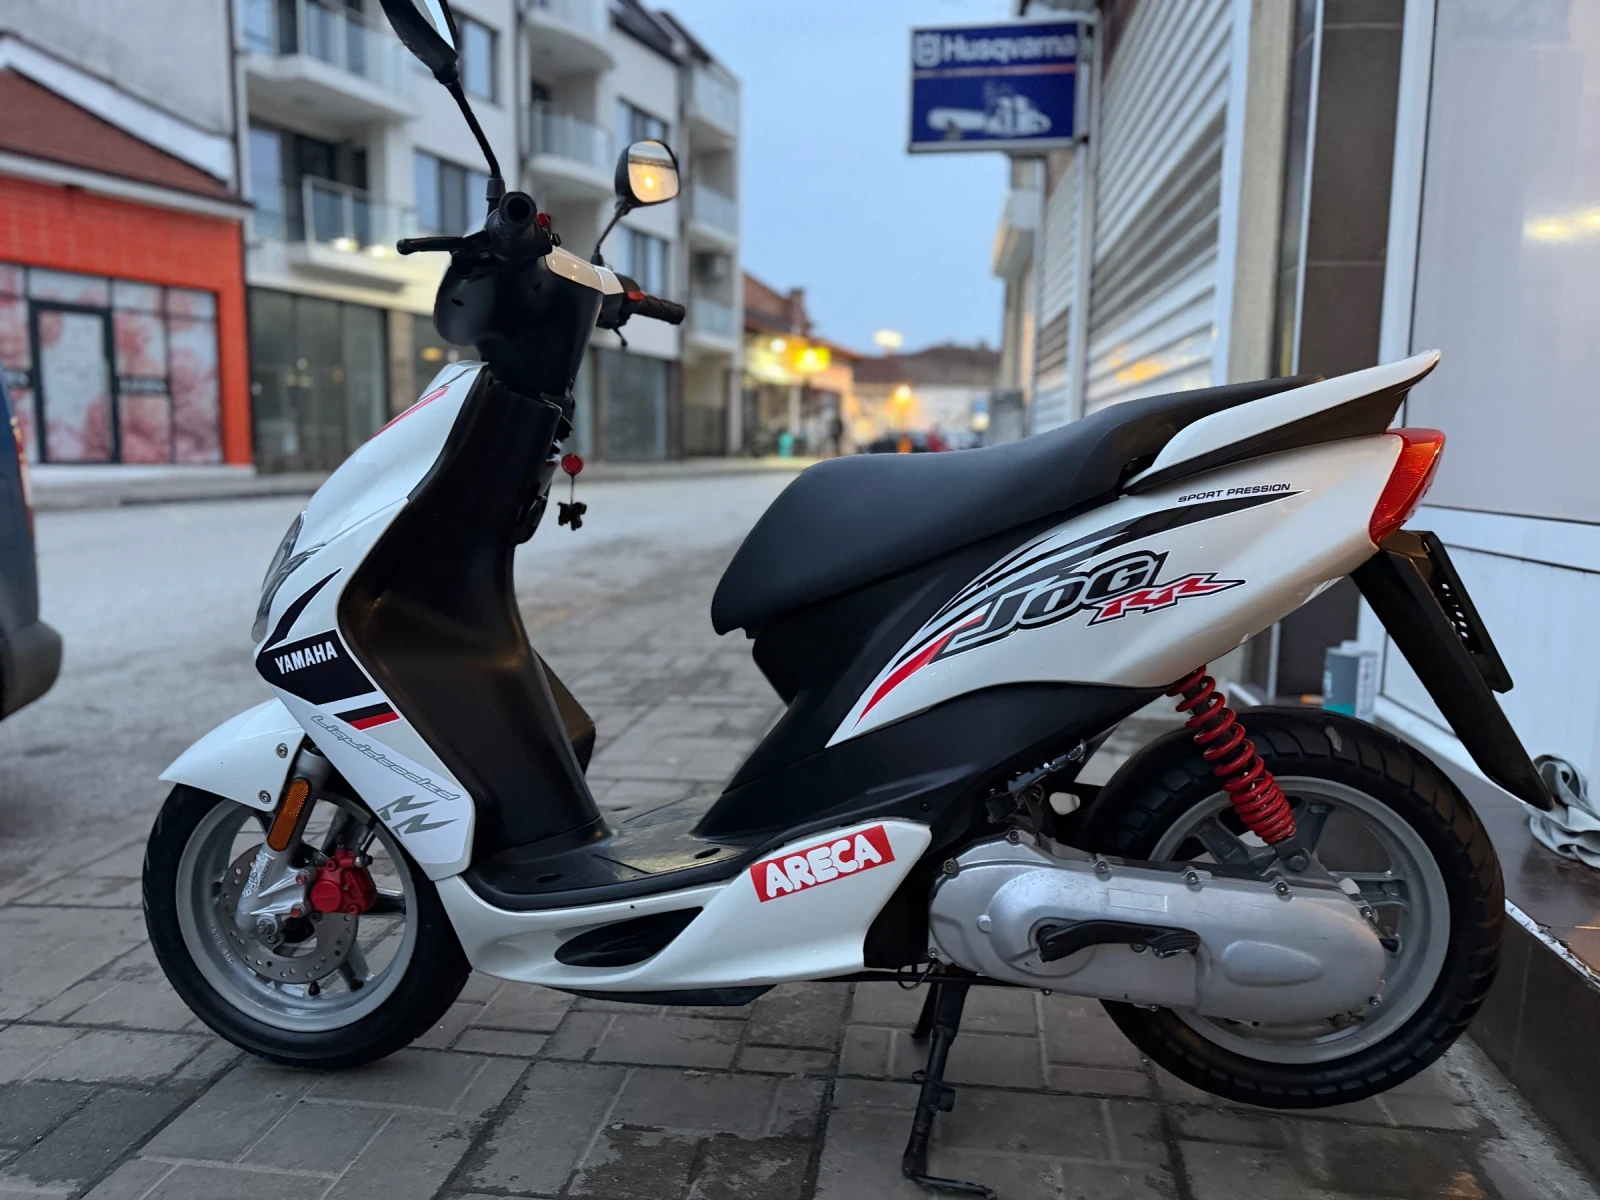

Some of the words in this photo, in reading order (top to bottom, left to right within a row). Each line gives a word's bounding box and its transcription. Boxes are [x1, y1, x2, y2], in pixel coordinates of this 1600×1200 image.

[943, 33, 1077, 64] Husqvarna
[1178, 490, 1223, 502] SPORT
[1226, 483, 1291, 496] PRESSION
[930, 551, 1169, 664] JOG
[274, 640, 339, 675] YAMAHA
[765, 833, 883, 898] ARECA
